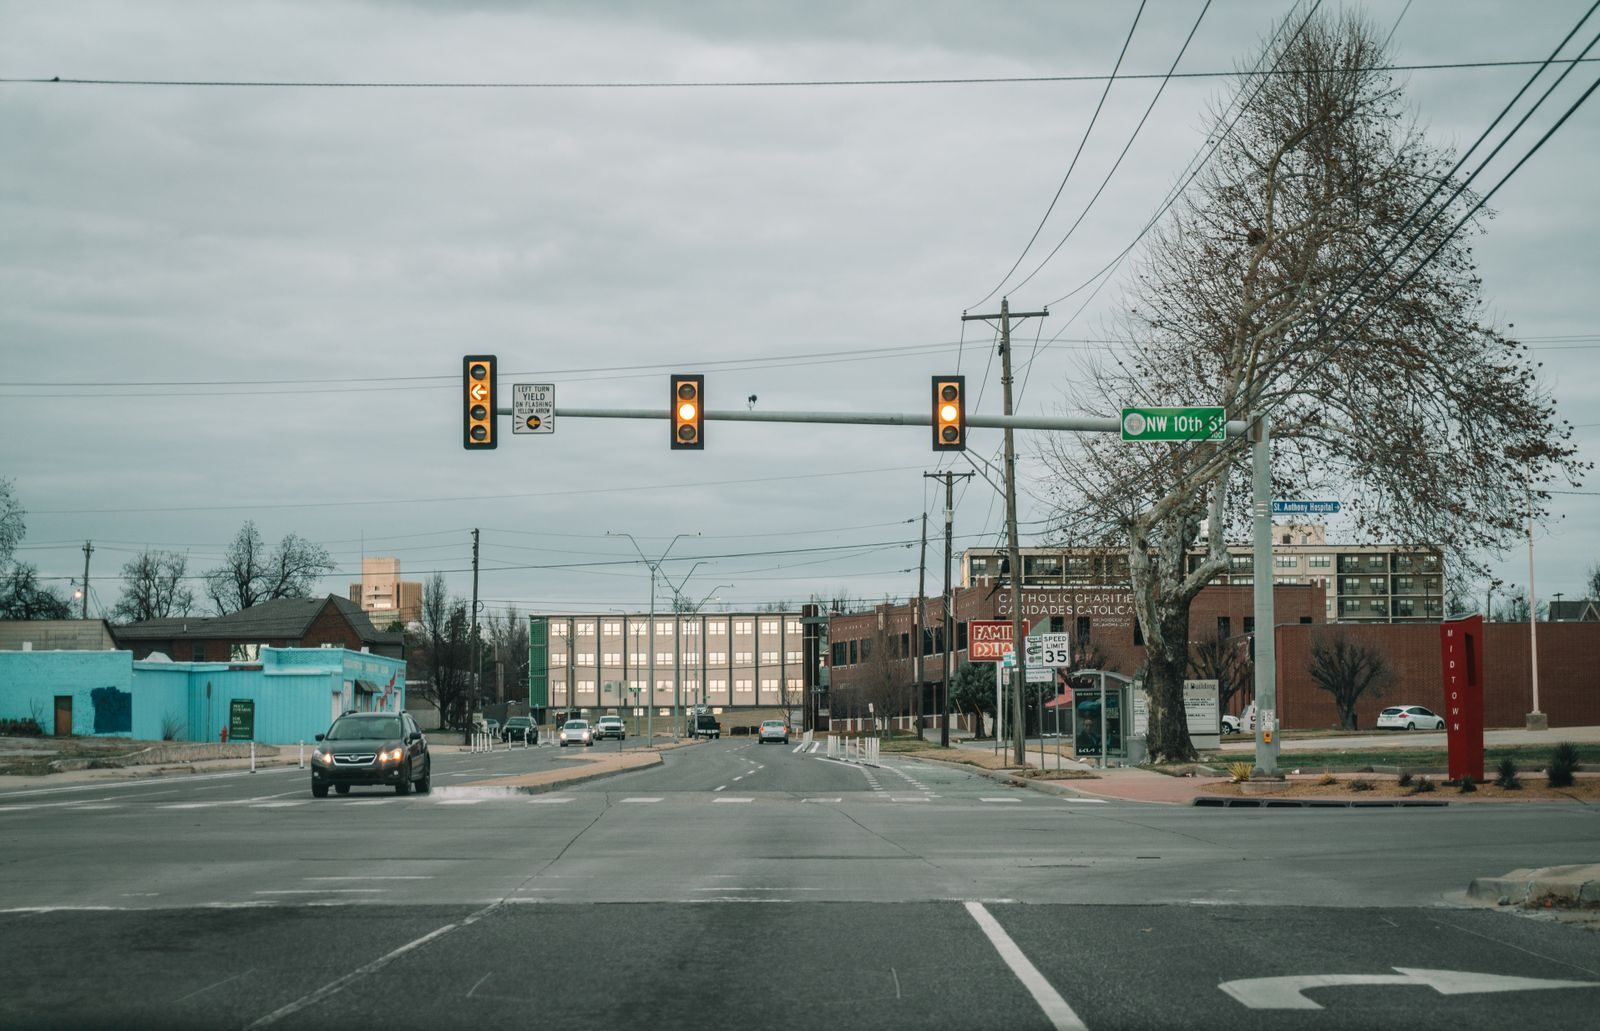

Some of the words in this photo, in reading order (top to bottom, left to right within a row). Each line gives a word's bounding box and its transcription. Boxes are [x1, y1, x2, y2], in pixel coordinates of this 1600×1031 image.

[1146, 416, 1167, 432] NW
[1174, 416, 1202, 432] 10th
[1208, 416, 1224, 432] St
[1284, 503, 1308, 512] Anthony
[1310, 503, 1334, 512] Hospital
[1075, 594, 1134, 603] CHARITIE
[974, 626, 1013, 640] FAMIL
[974, 642, 1013, 657] DOLLA
[1045, 650, 1067, 663] 35
[1448, 630, 1459, 731] MIDTOWN
